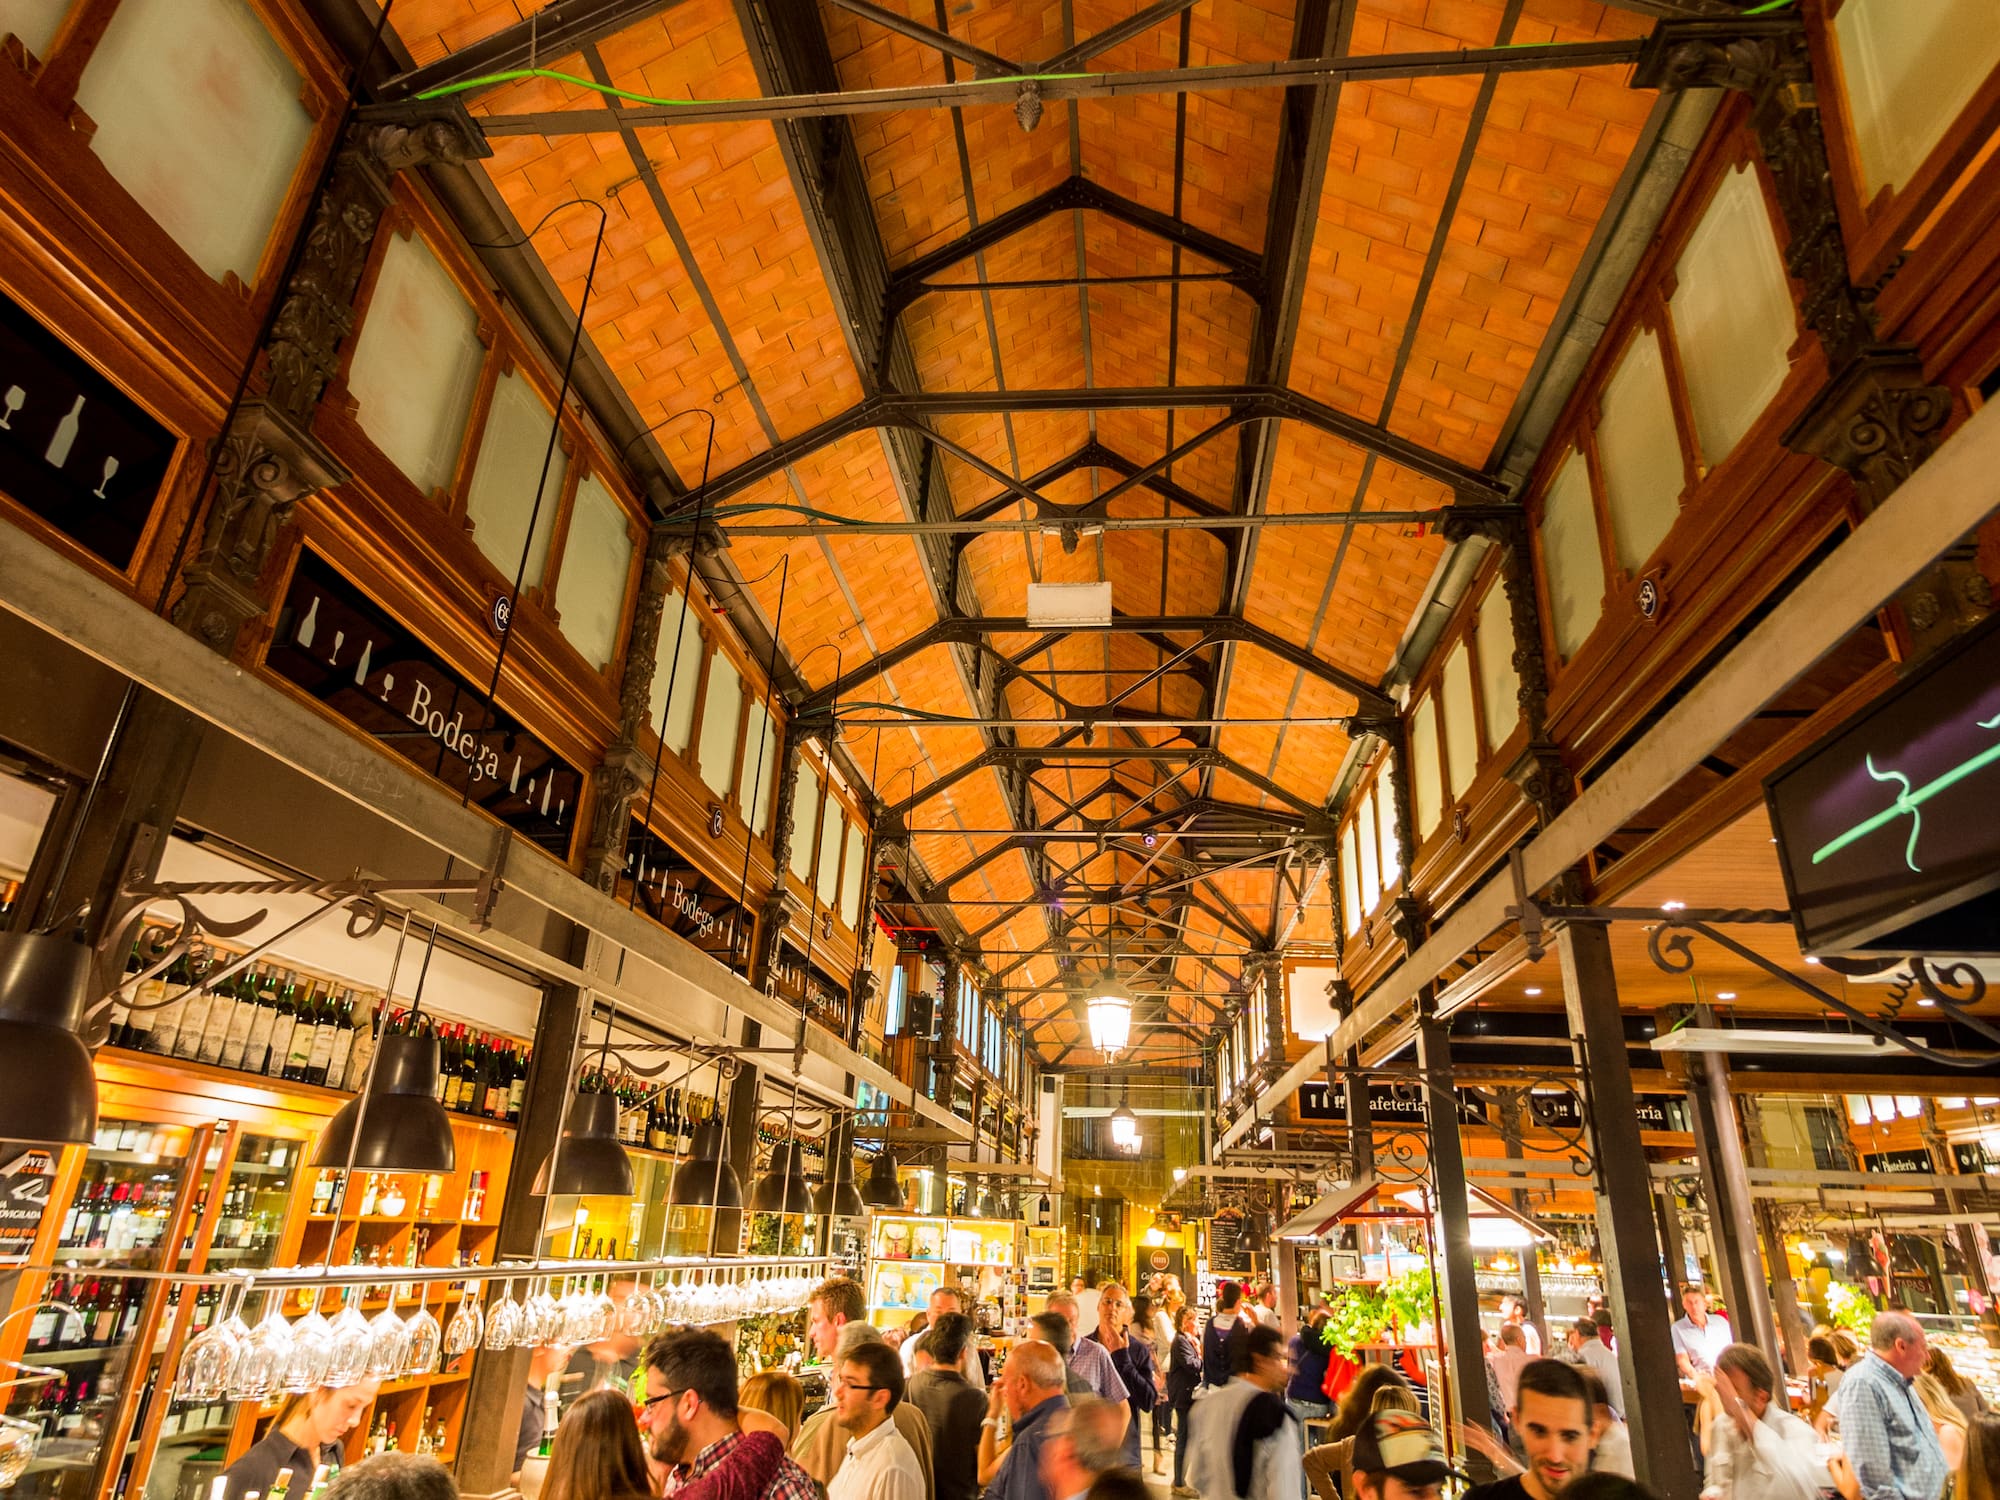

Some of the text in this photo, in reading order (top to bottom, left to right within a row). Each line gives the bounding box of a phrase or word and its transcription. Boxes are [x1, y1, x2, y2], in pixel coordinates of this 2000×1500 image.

[406, 679, 499, 782] Bodega
[672, 879, 714, 938] Bodega
[1635, 1104, 1664, 1120] ería
[1896, 1279, 1926, 1292] TAPAS
